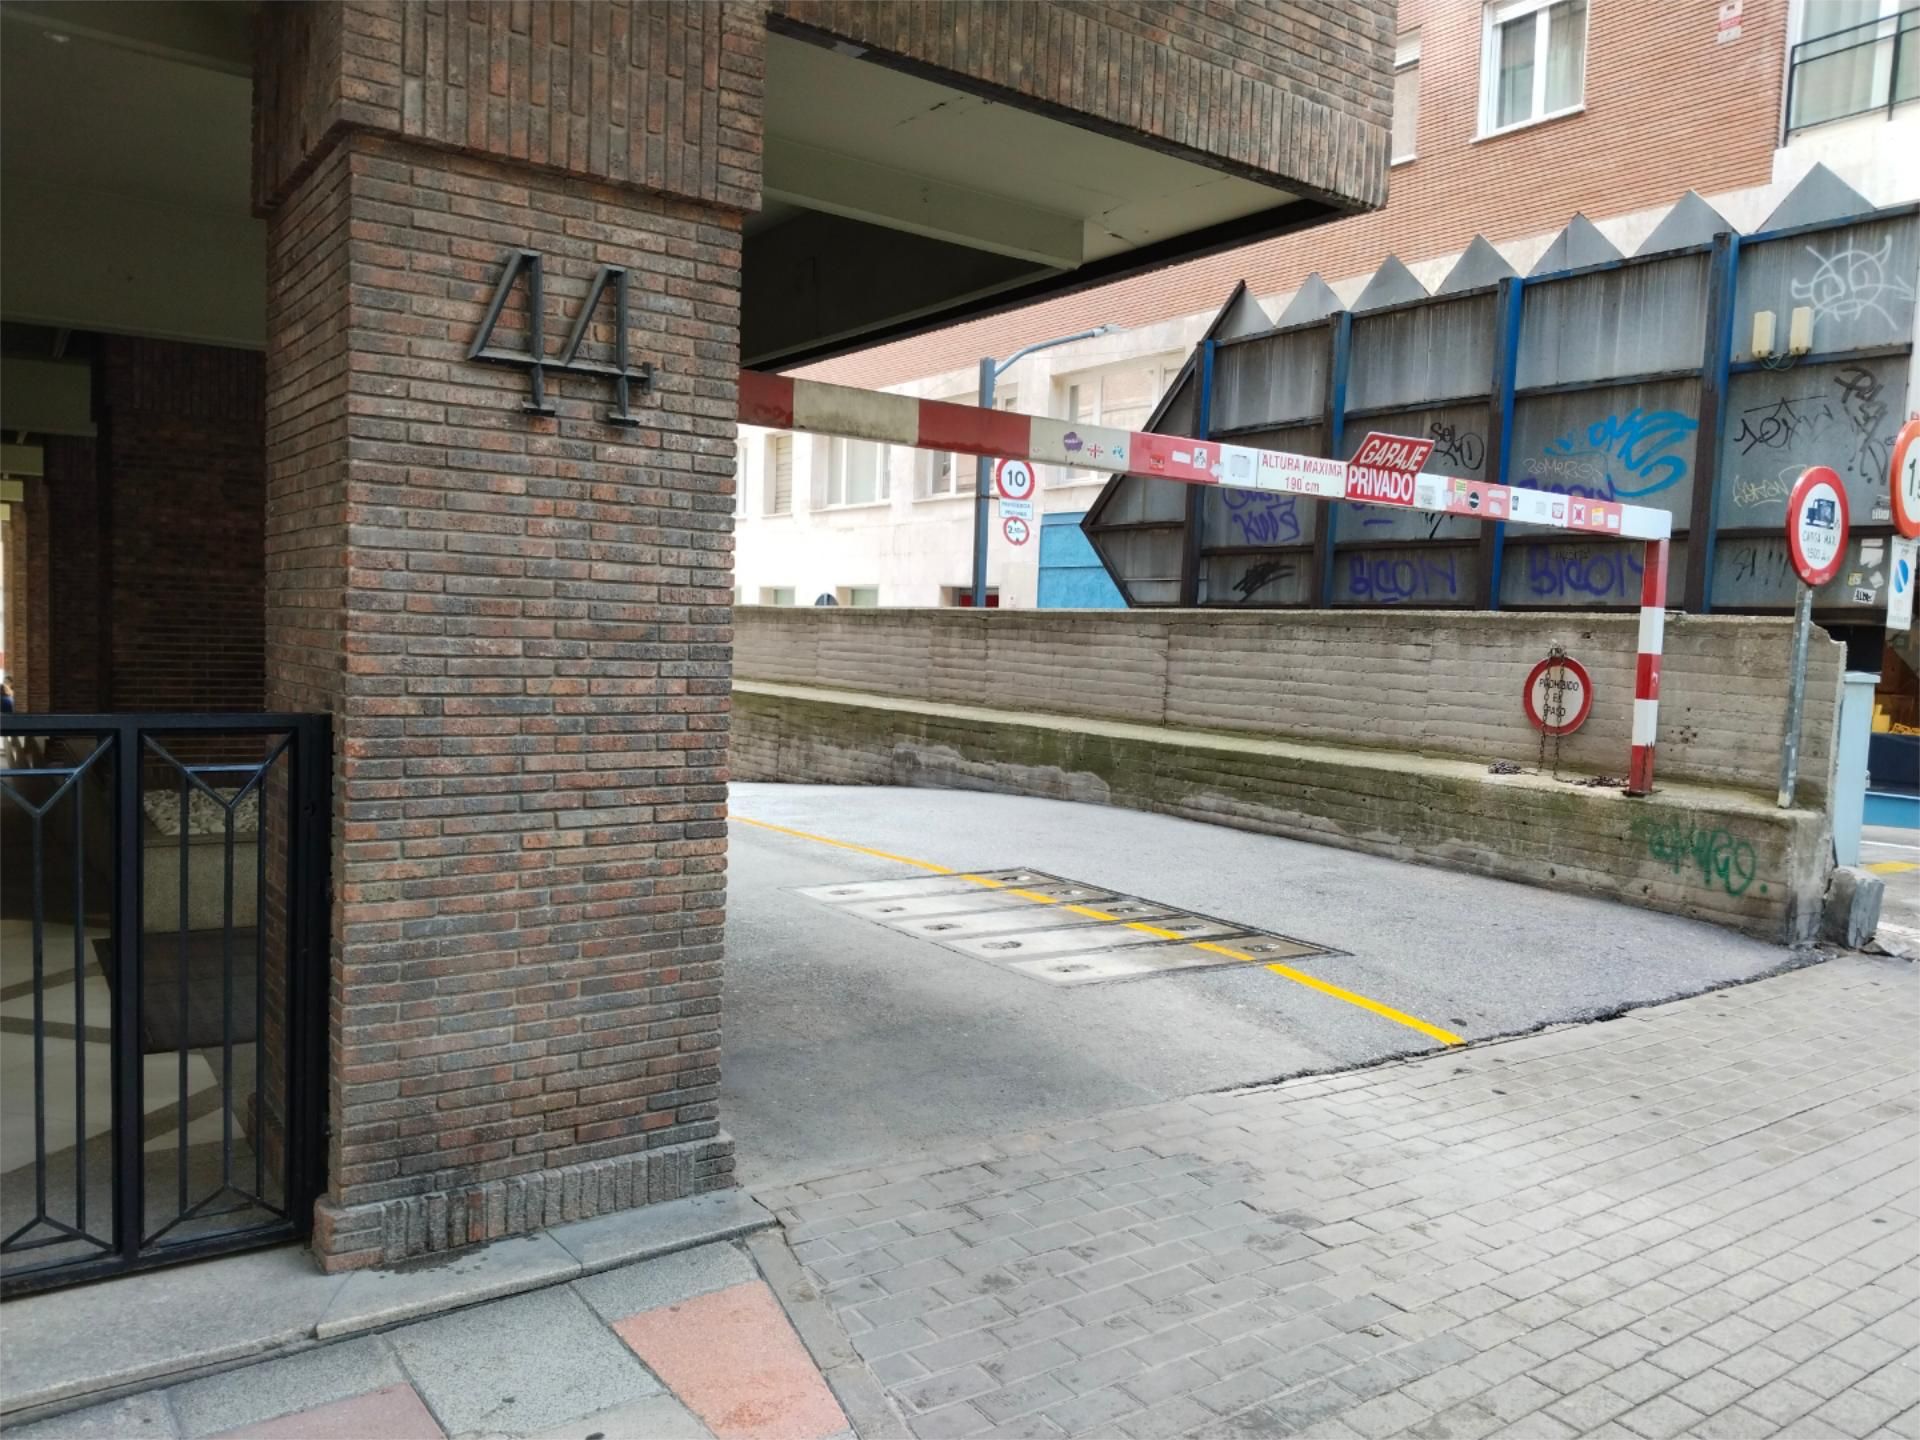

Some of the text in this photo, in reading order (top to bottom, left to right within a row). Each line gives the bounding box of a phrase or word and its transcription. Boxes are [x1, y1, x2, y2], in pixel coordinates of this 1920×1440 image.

[468, 248, 655, 427] 44
[1261, 453, 1343, 478] ALTURA MAXIMA
[1359, 439, 1428, 472] GARAJE
[1007, 469, 1026, 487] 10
[1284, 477, 1320, 493] 190 cm
[1347, 466, 1413, 502] PRIVADO
